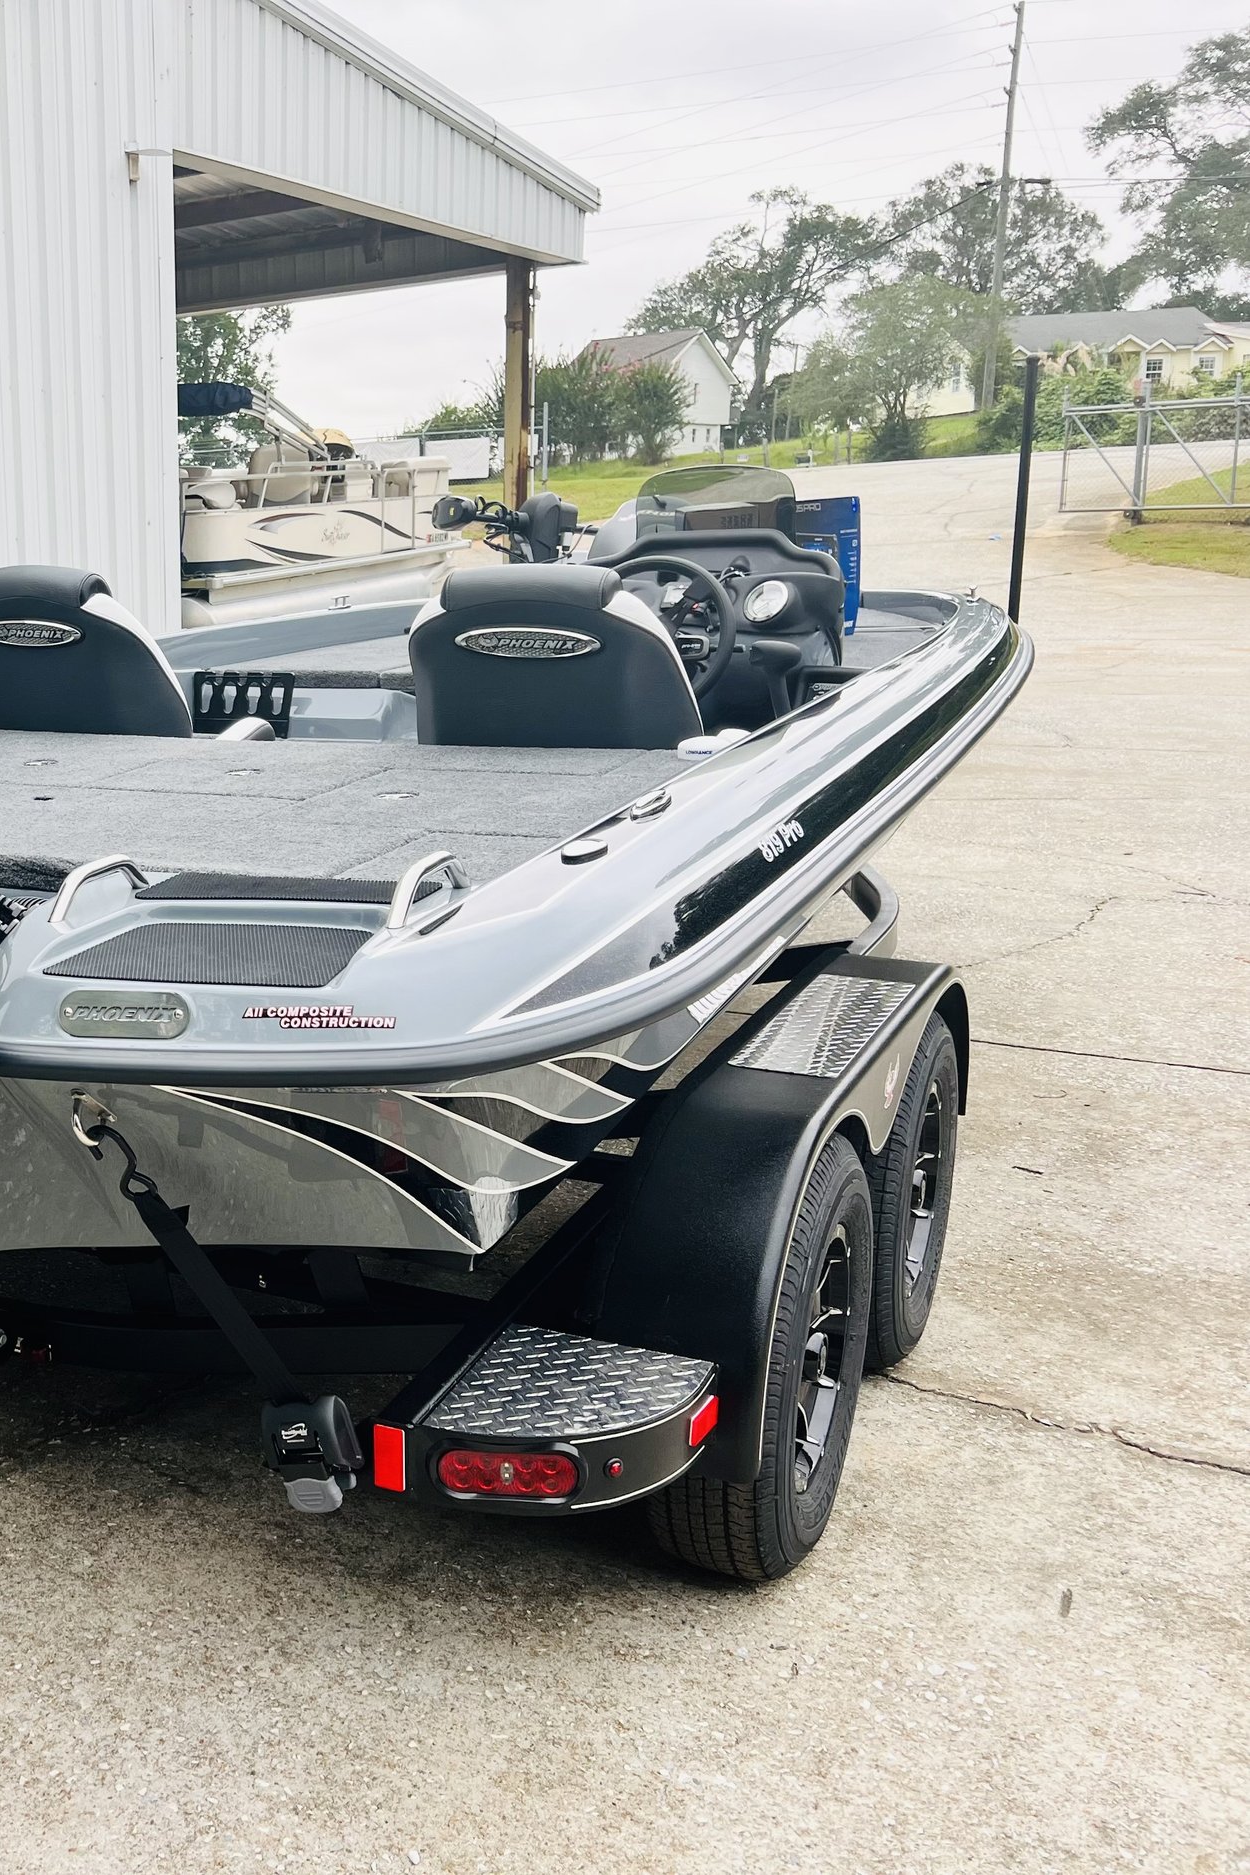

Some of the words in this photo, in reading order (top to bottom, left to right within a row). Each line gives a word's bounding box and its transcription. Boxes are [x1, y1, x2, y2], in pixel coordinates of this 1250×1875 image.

[7, 629, 63, 639] PHOENIX
[498, 638, 577, 650] PHOENIX
[758, 830, 784, 862] 819
[777, 820, 804, 847] Pro
[70, 1005, 177, 1022] PHOENIX
[266, 1005, 353, 1018] COMPOSITE
[280, 1017, 395, 1029] CONSTRUCTION
